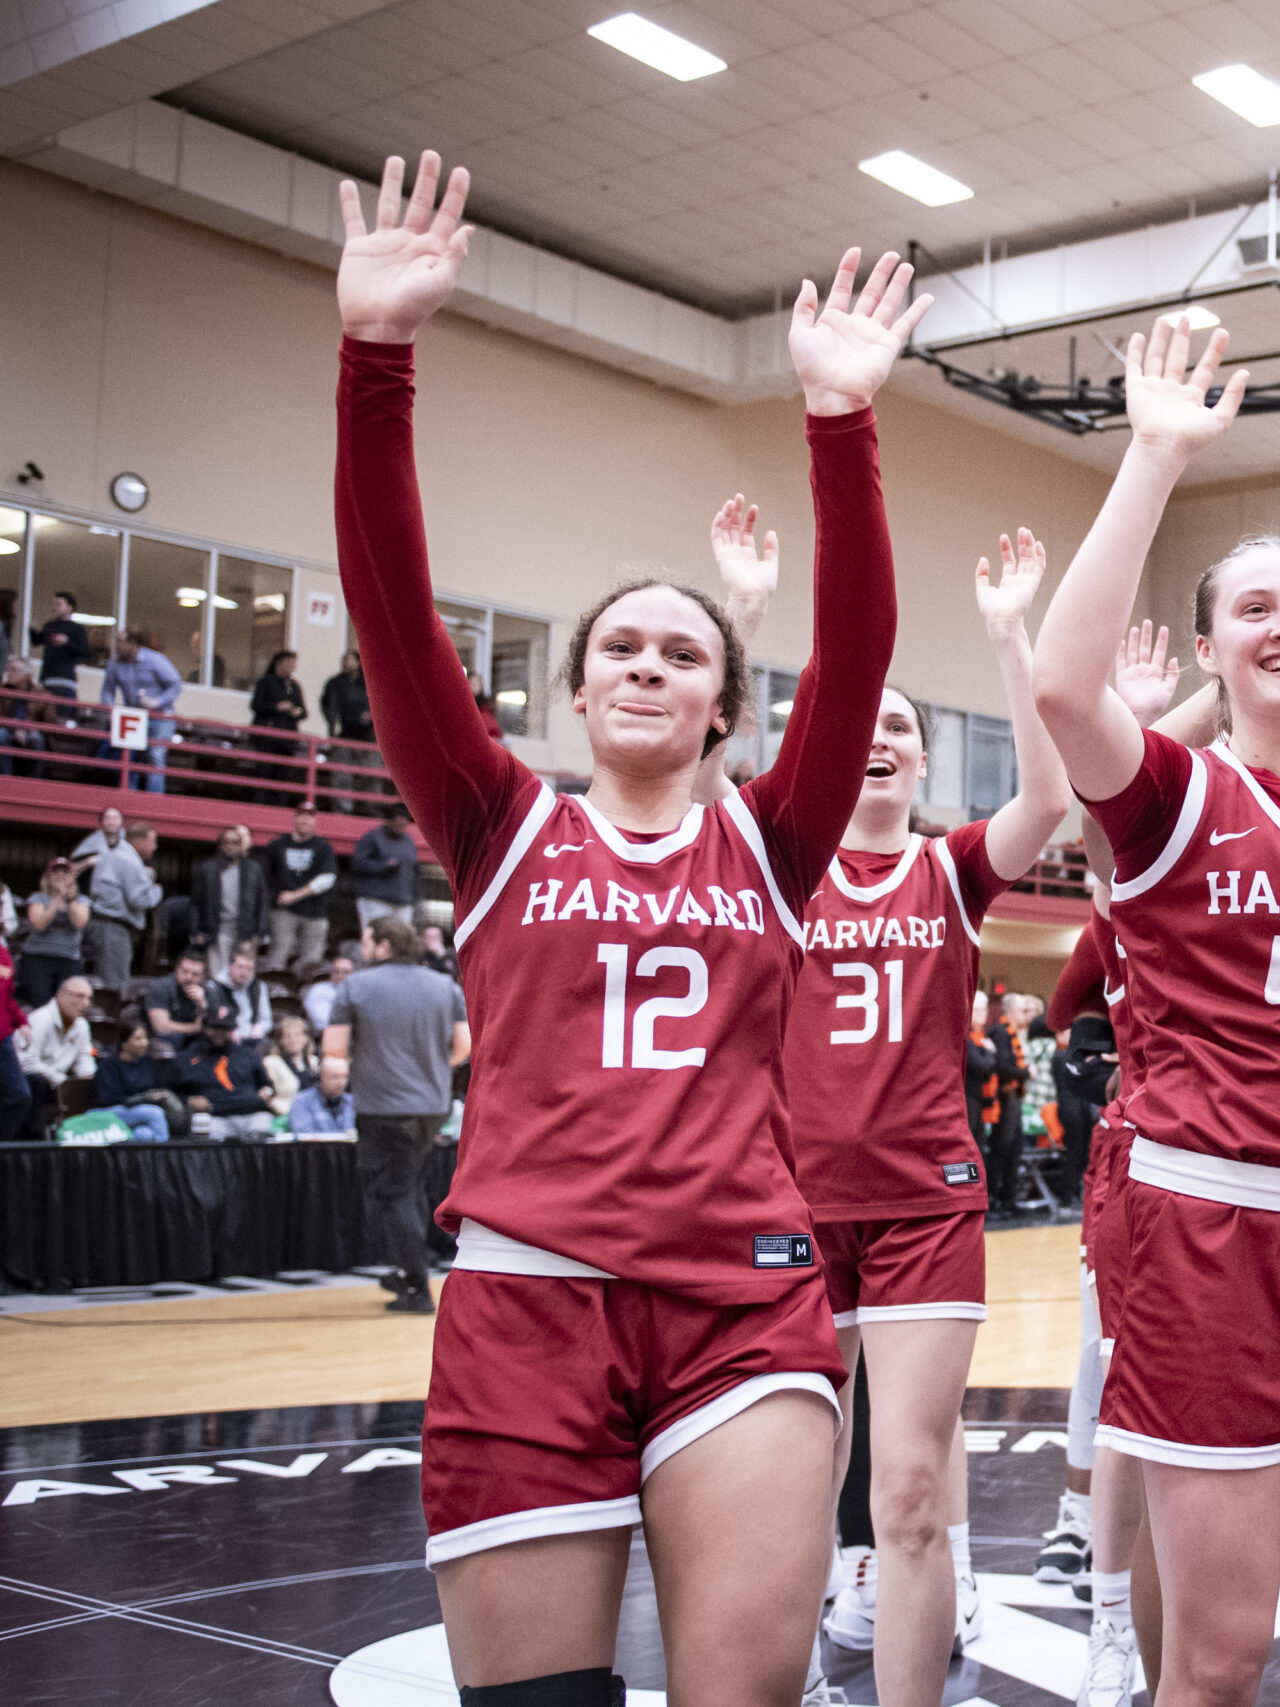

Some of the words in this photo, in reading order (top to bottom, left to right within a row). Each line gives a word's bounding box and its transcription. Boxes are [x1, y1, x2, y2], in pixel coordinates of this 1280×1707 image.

[119, 715, 141, 740] F
[521, 877, 765, 935] HARVARD
[597, 942, 709, 1070] 12
[830, 960, 904, 1045] 31
[796, 1243, 807, 1257] M
